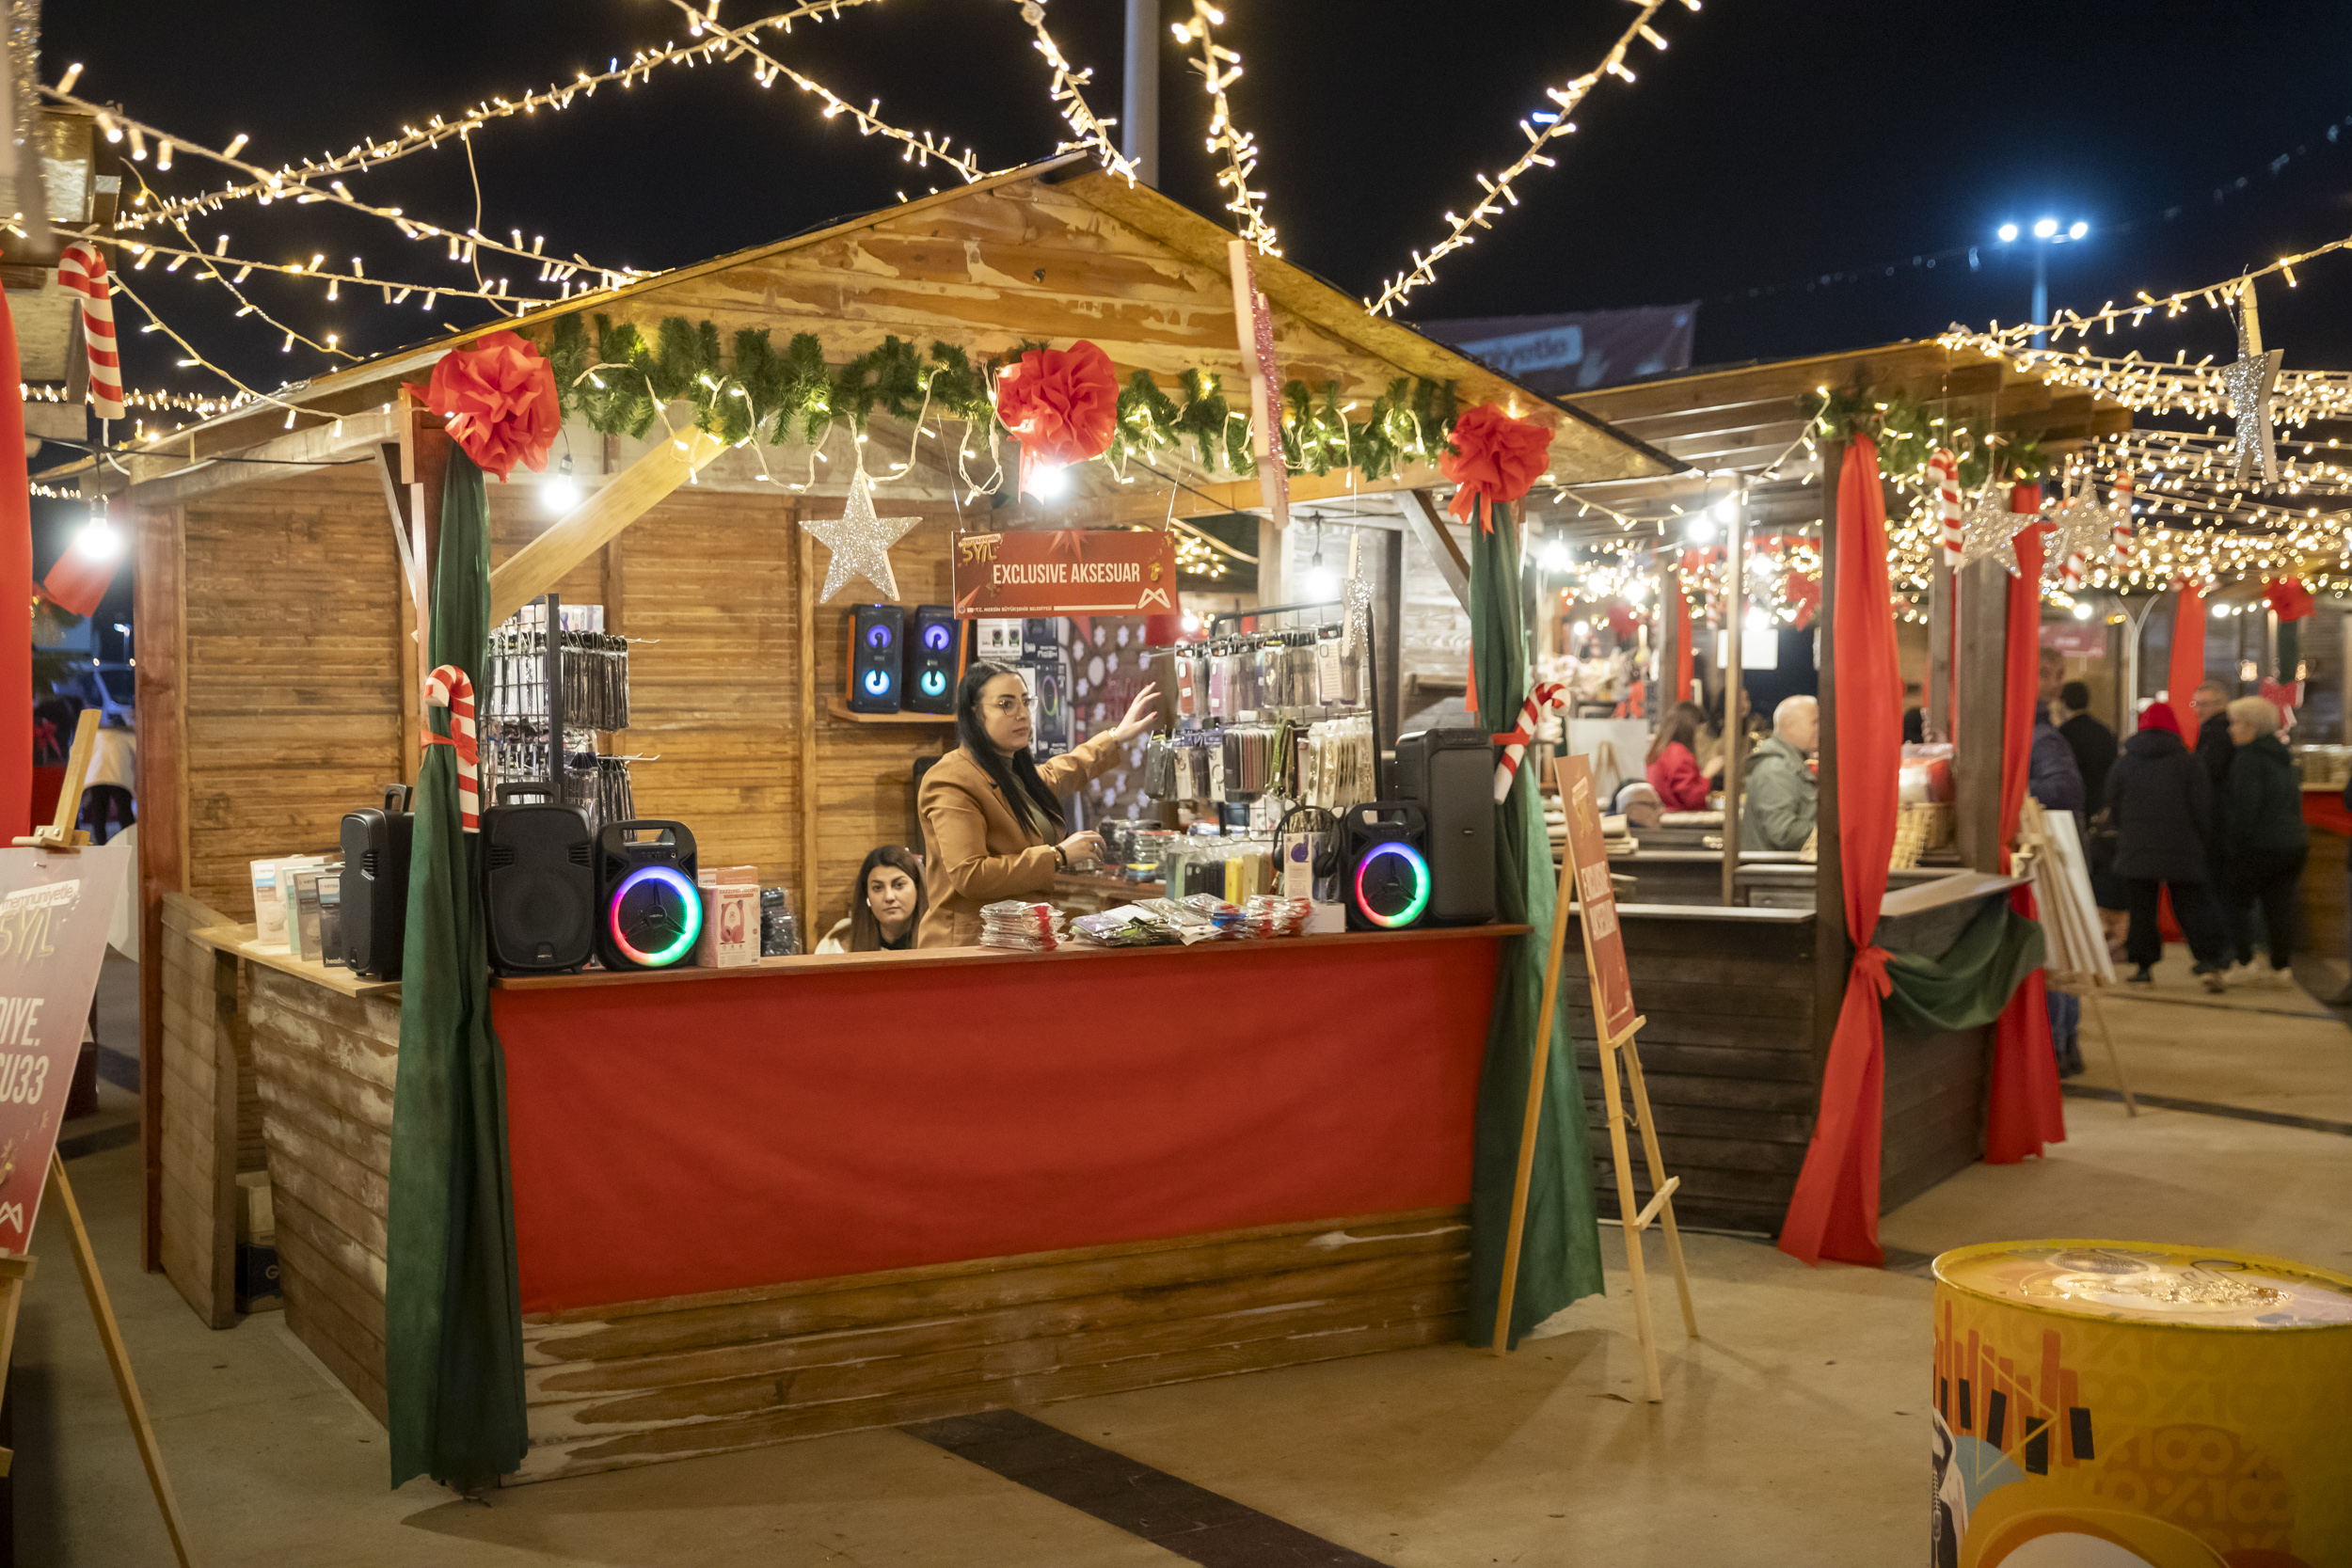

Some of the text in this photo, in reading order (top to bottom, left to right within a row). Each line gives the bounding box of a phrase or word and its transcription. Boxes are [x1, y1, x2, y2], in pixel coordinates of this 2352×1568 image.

[993, 562, 1140, 585] EXCLUSIVE AKSESUAR
[1, 883, 73, 911] memnuniyetle
[0, 1053, 49, 1104] U33
